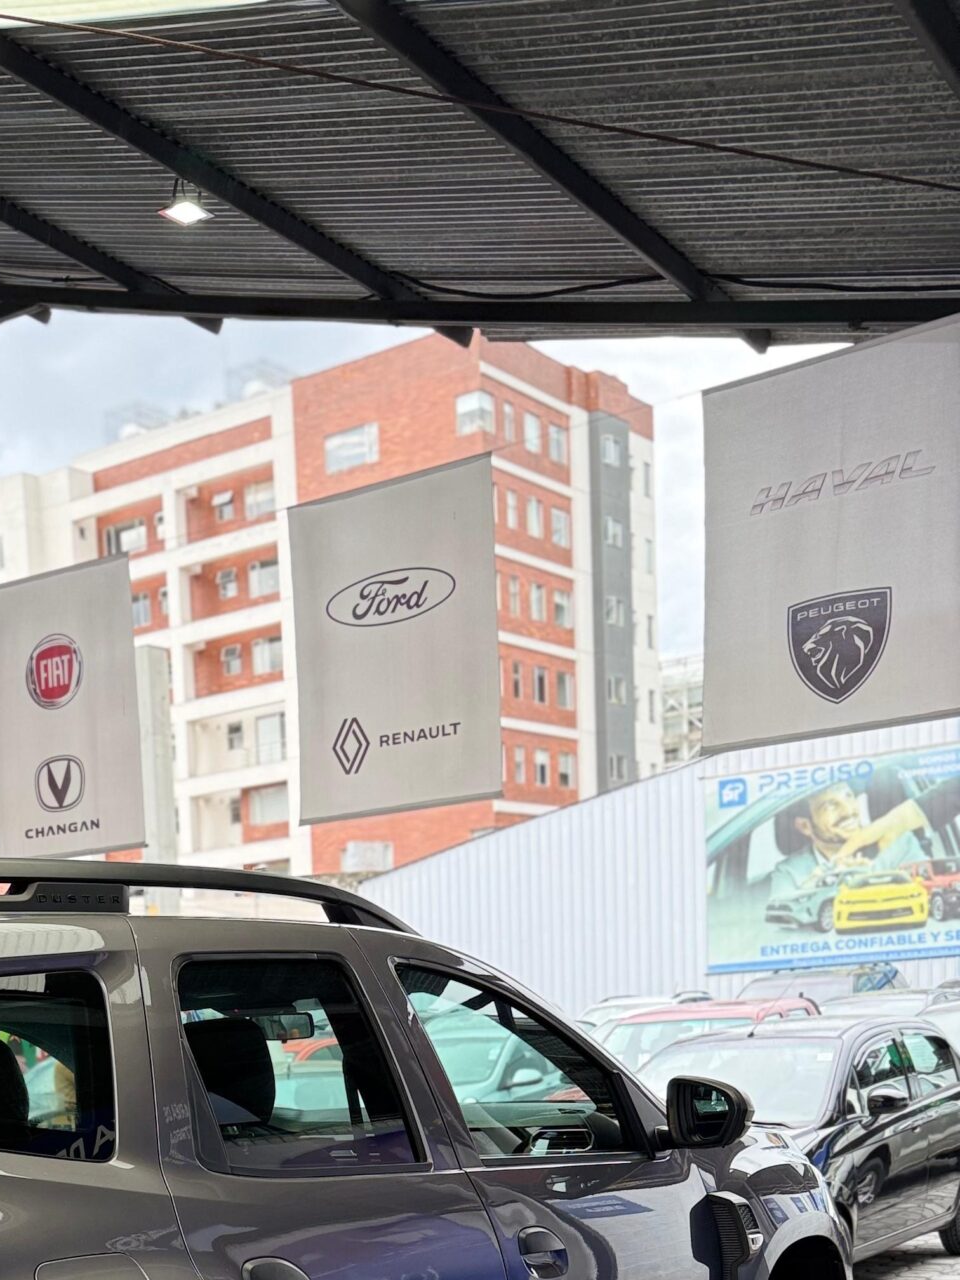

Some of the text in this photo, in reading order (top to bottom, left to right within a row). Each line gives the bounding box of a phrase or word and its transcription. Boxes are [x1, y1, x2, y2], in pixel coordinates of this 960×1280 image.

[749, 449, 936, 516] HAVAL
[352, 576, 429, 620] Ford
[797, 598, 881, 621] PEUGEOT
[40, 654, 70, 690] FIAT
[379, 722, 461, 747] RENAULT
[758, 760, 873, 793] PRECISO
[24, 818, 100, 839] CHANGAN
[38, 893, 120, 904] DUSTER
[760, 940, 831, 957] ENTREGA
[835, 933, 926, 951] CONFIABLE
[930, 931, 940, 943] Y
